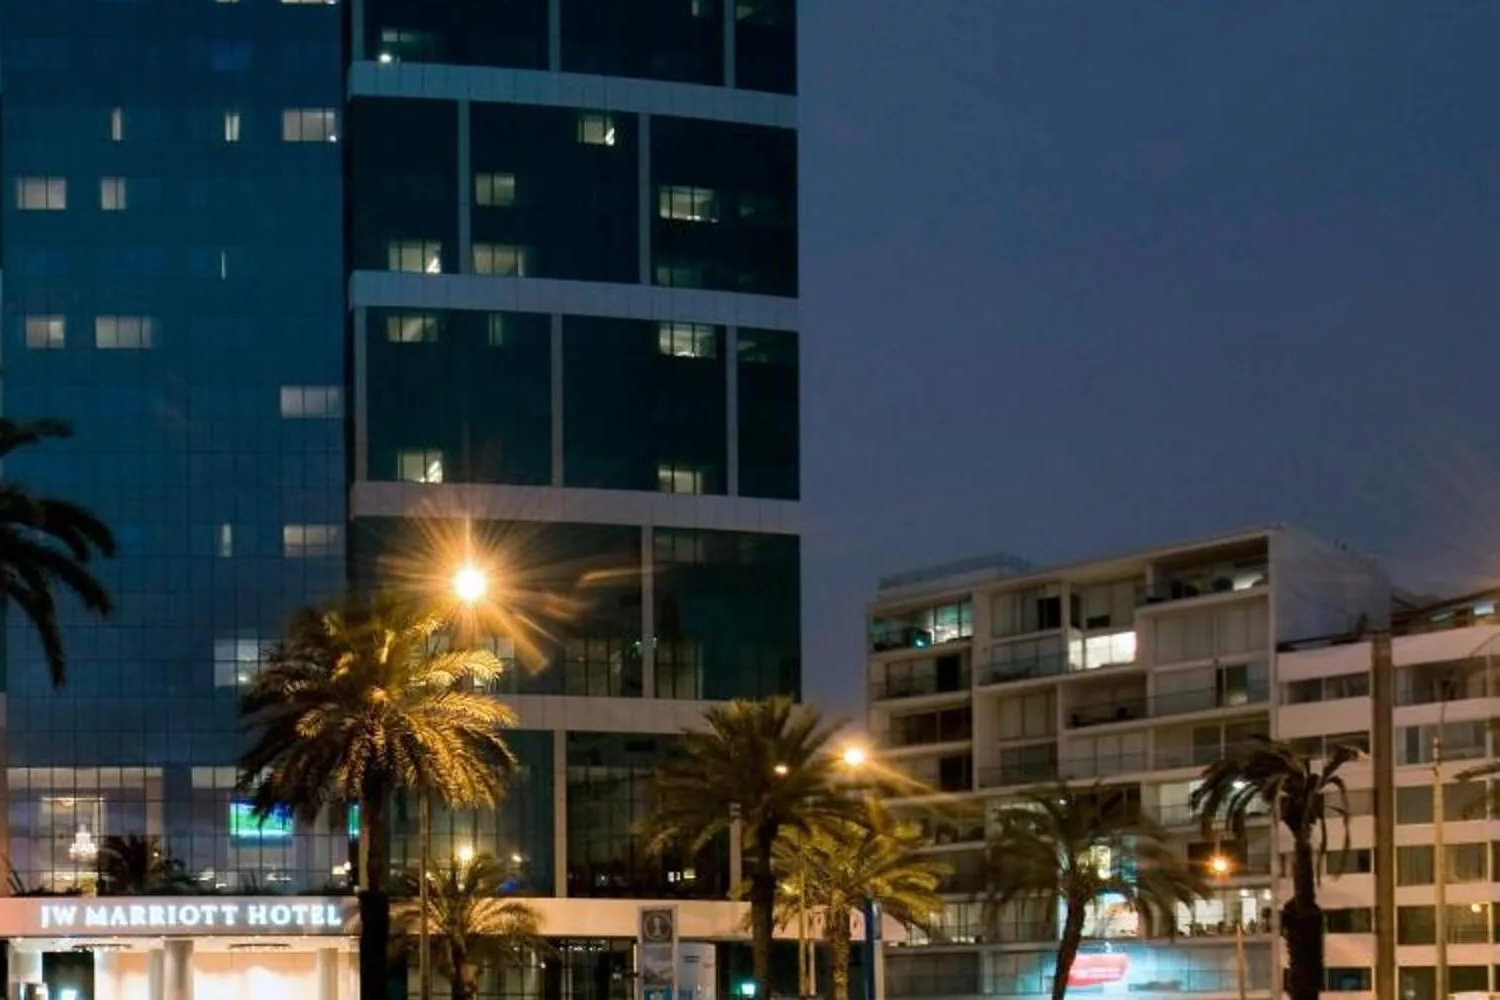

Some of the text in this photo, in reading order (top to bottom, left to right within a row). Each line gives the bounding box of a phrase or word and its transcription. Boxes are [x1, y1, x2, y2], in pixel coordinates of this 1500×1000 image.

[40, 904, 342, 929] JW MARRIOTT HOTEL
